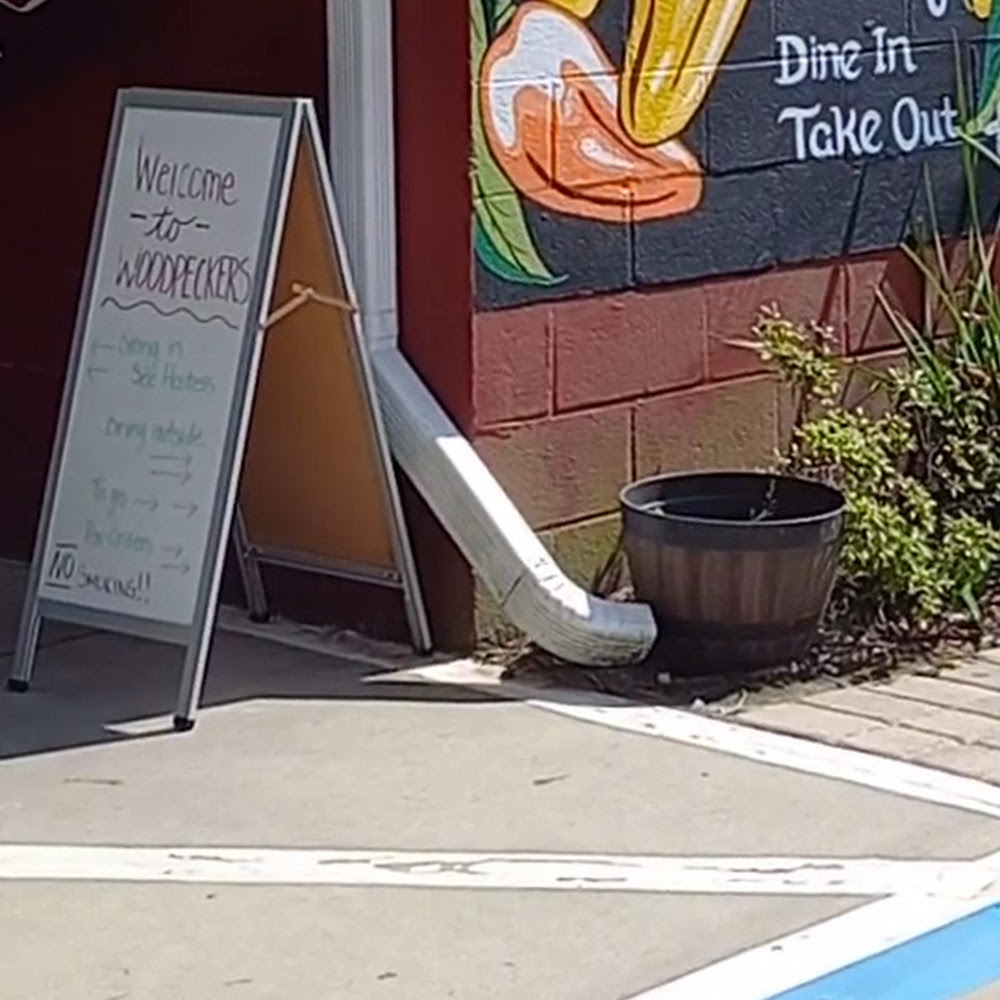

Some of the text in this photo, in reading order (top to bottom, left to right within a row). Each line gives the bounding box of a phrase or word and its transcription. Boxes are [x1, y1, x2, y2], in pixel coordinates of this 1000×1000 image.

[774, 26, 917, 85] Dine In
[777, 96, 961, 160] Take Out
[135, 137, 239, 206] Welcome
[115, 246, 251, 304] WOODPECKERS
[49, 550, 76, 580] NO
